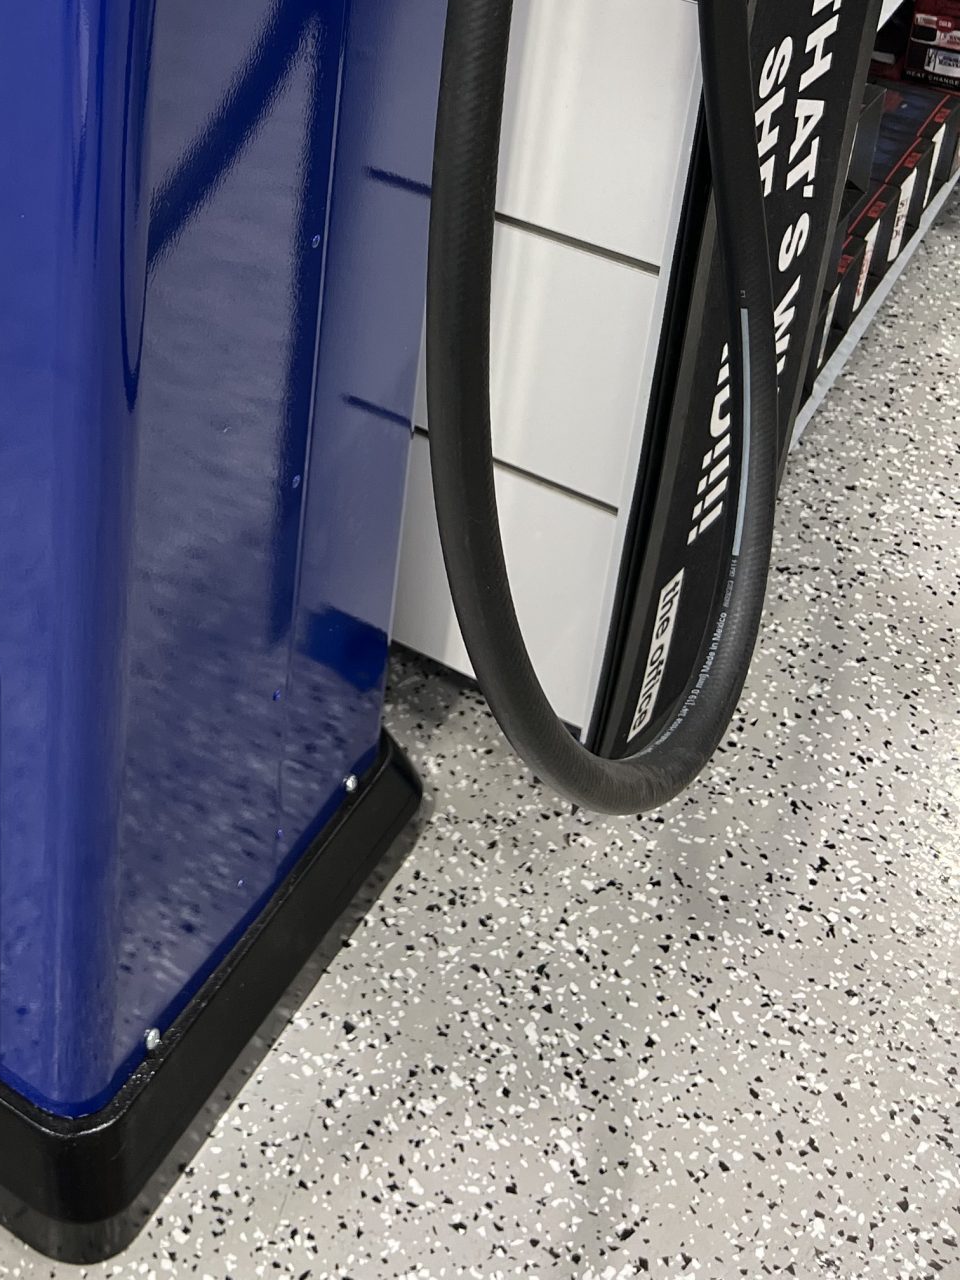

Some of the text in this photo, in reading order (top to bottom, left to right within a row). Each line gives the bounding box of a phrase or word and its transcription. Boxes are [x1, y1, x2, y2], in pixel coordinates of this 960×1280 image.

[655, 580, 681, 640] the
[701, 649, 716, 675] Made
[712, 612, 728, 641] Mexico
[632, 642, 665, 731] office
